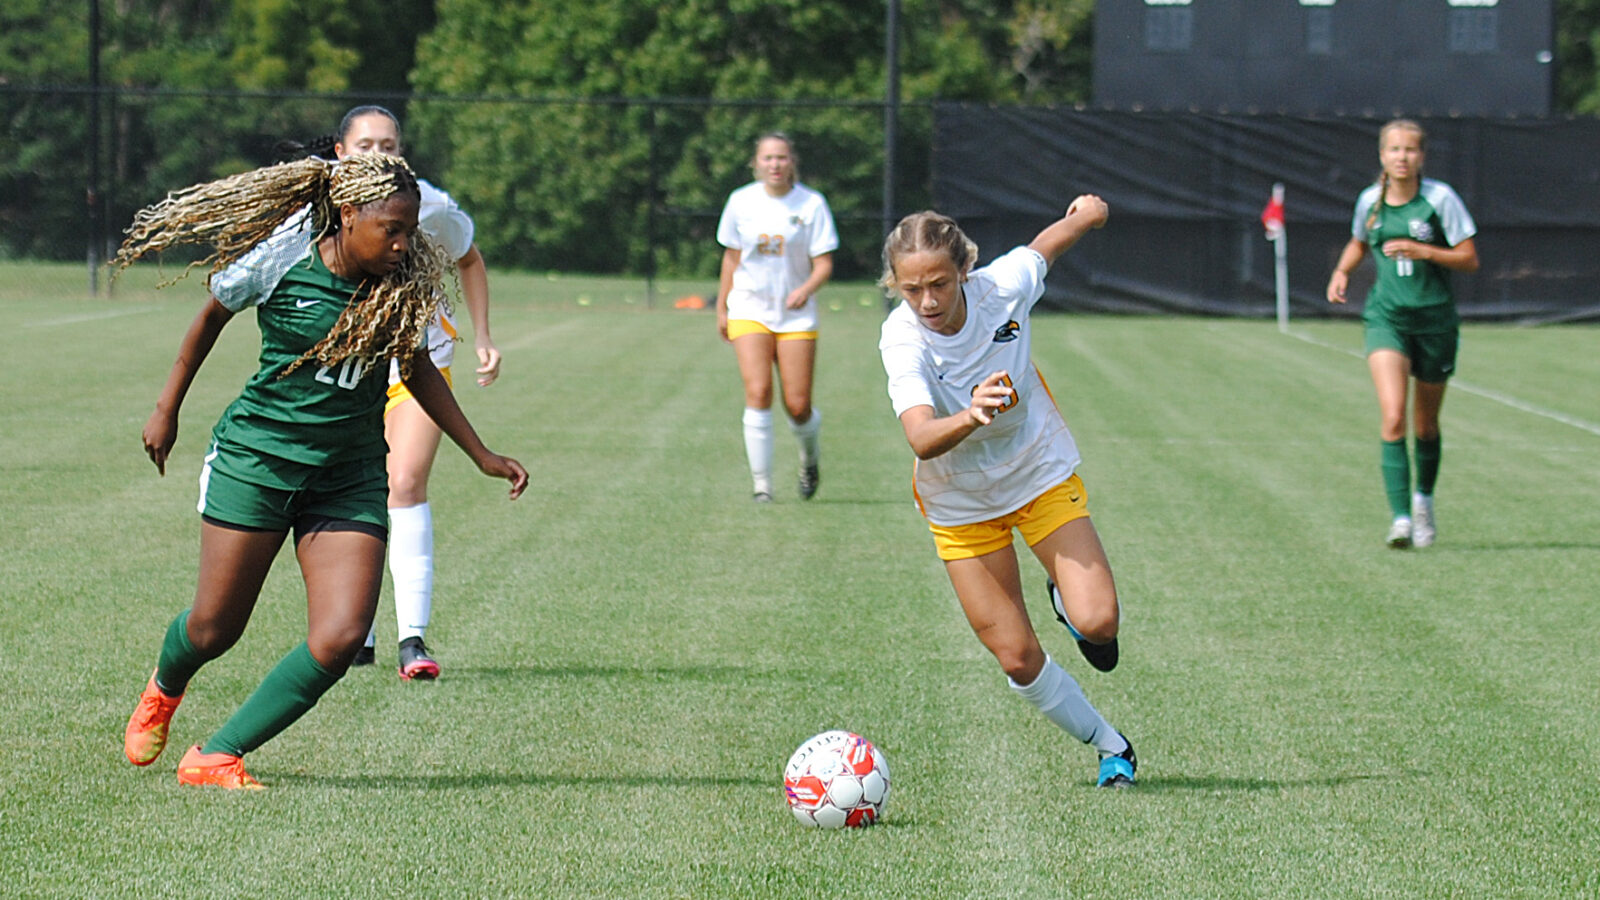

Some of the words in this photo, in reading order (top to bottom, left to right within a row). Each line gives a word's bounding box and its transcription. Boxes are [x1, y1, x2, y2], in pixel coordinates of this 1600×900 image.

[757, 233, 785, 256] 23
[314, 353, 364, 391] 20
[971, 371, 1019, 418] 3
